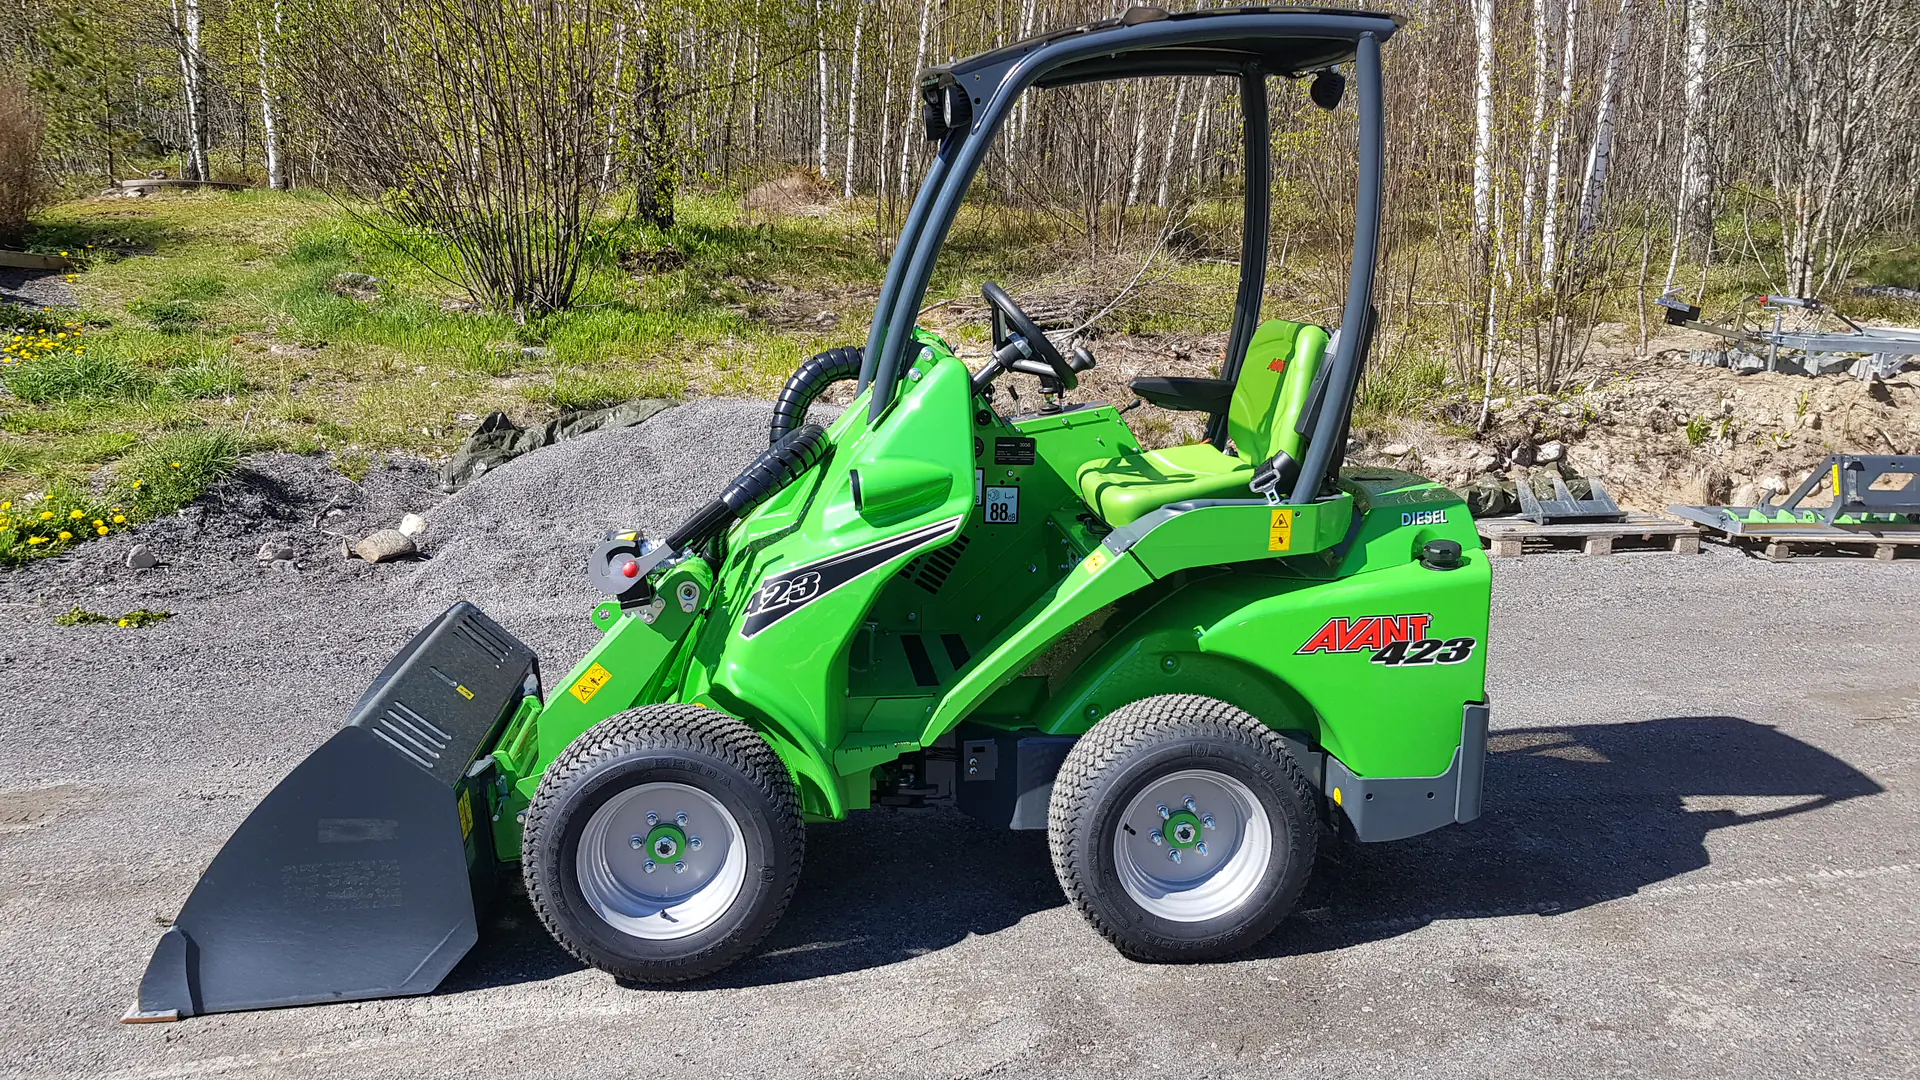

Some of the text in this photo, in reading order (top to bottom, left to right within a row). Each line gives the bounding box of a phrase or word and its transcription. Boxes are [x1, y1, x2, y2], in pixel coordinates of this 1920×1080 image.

[990, 502, 1009, 521] 88
[1401, 509, 1448, 526] DIESEL
[742, 570, 822, 617] 423
[1293, 613, 1433, 655] AVANT
[1369, 637, 1477, 668] 423
